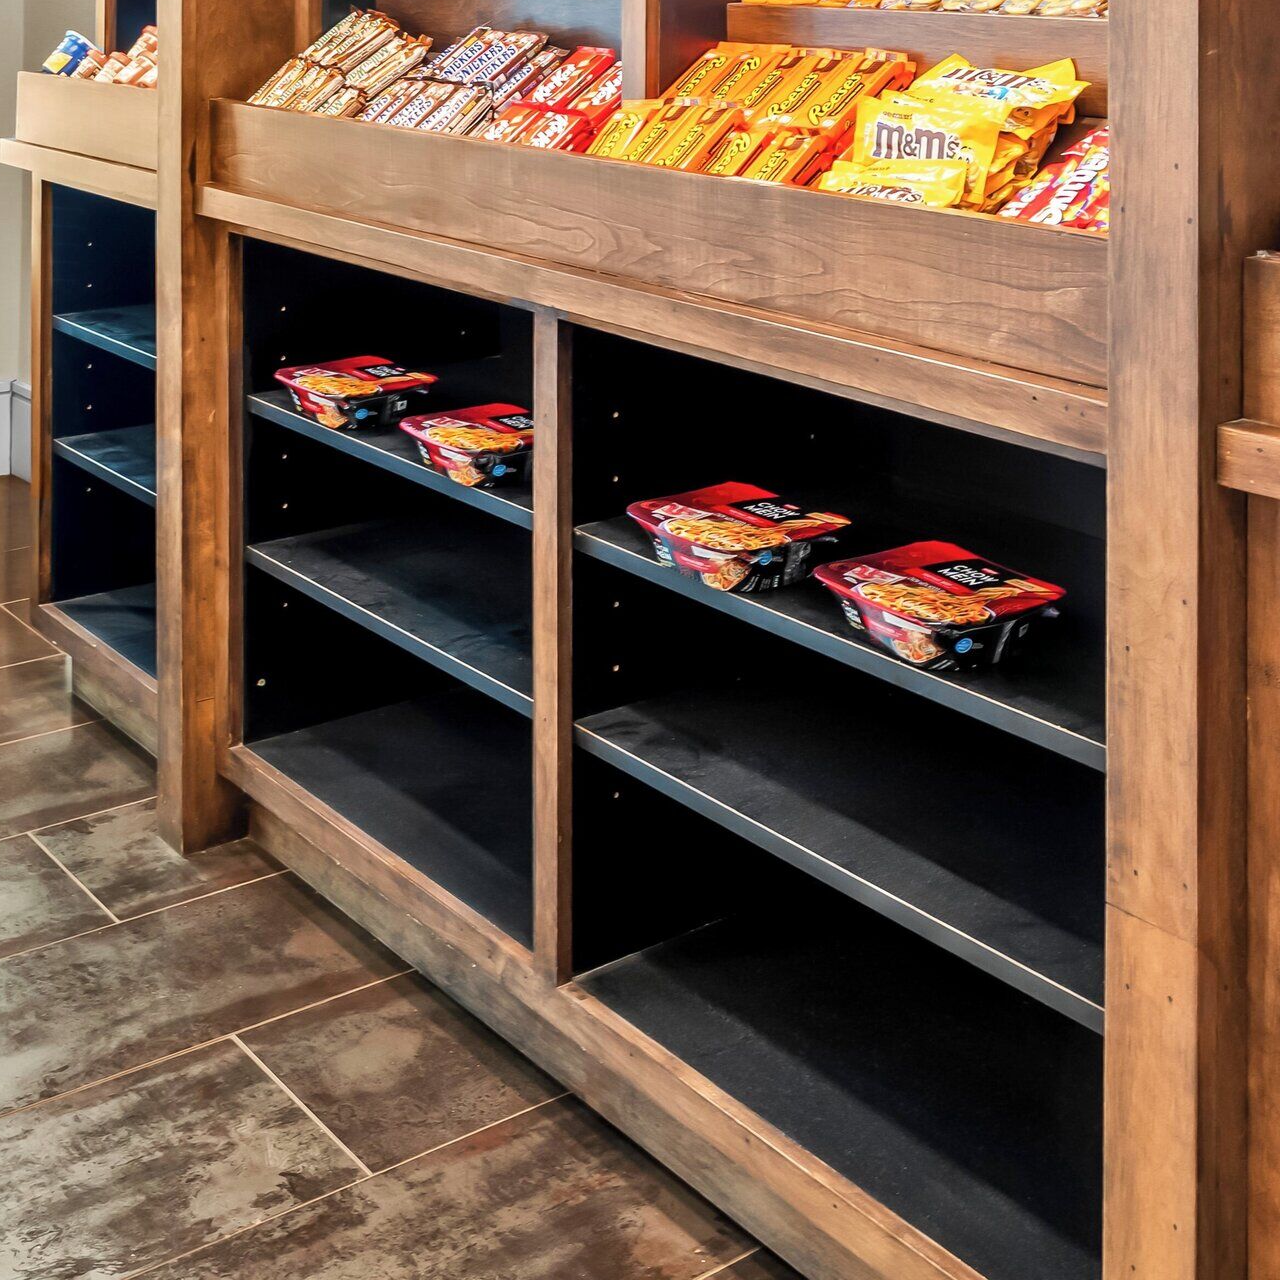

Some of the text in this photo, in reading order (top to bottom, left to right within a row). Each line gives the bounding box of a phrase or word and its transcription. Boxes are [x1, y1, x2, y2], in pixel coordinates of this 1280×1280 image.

[767, 70, 819, 118] Reese's
[807, 71, 863, 127] Reese's
[743, 504, 788, 520] MEIN
[757, 501, 802, 517] CHOW
[937, 568, 984, 586] MEIN
[952, 564, 1000, 583] CHOW
